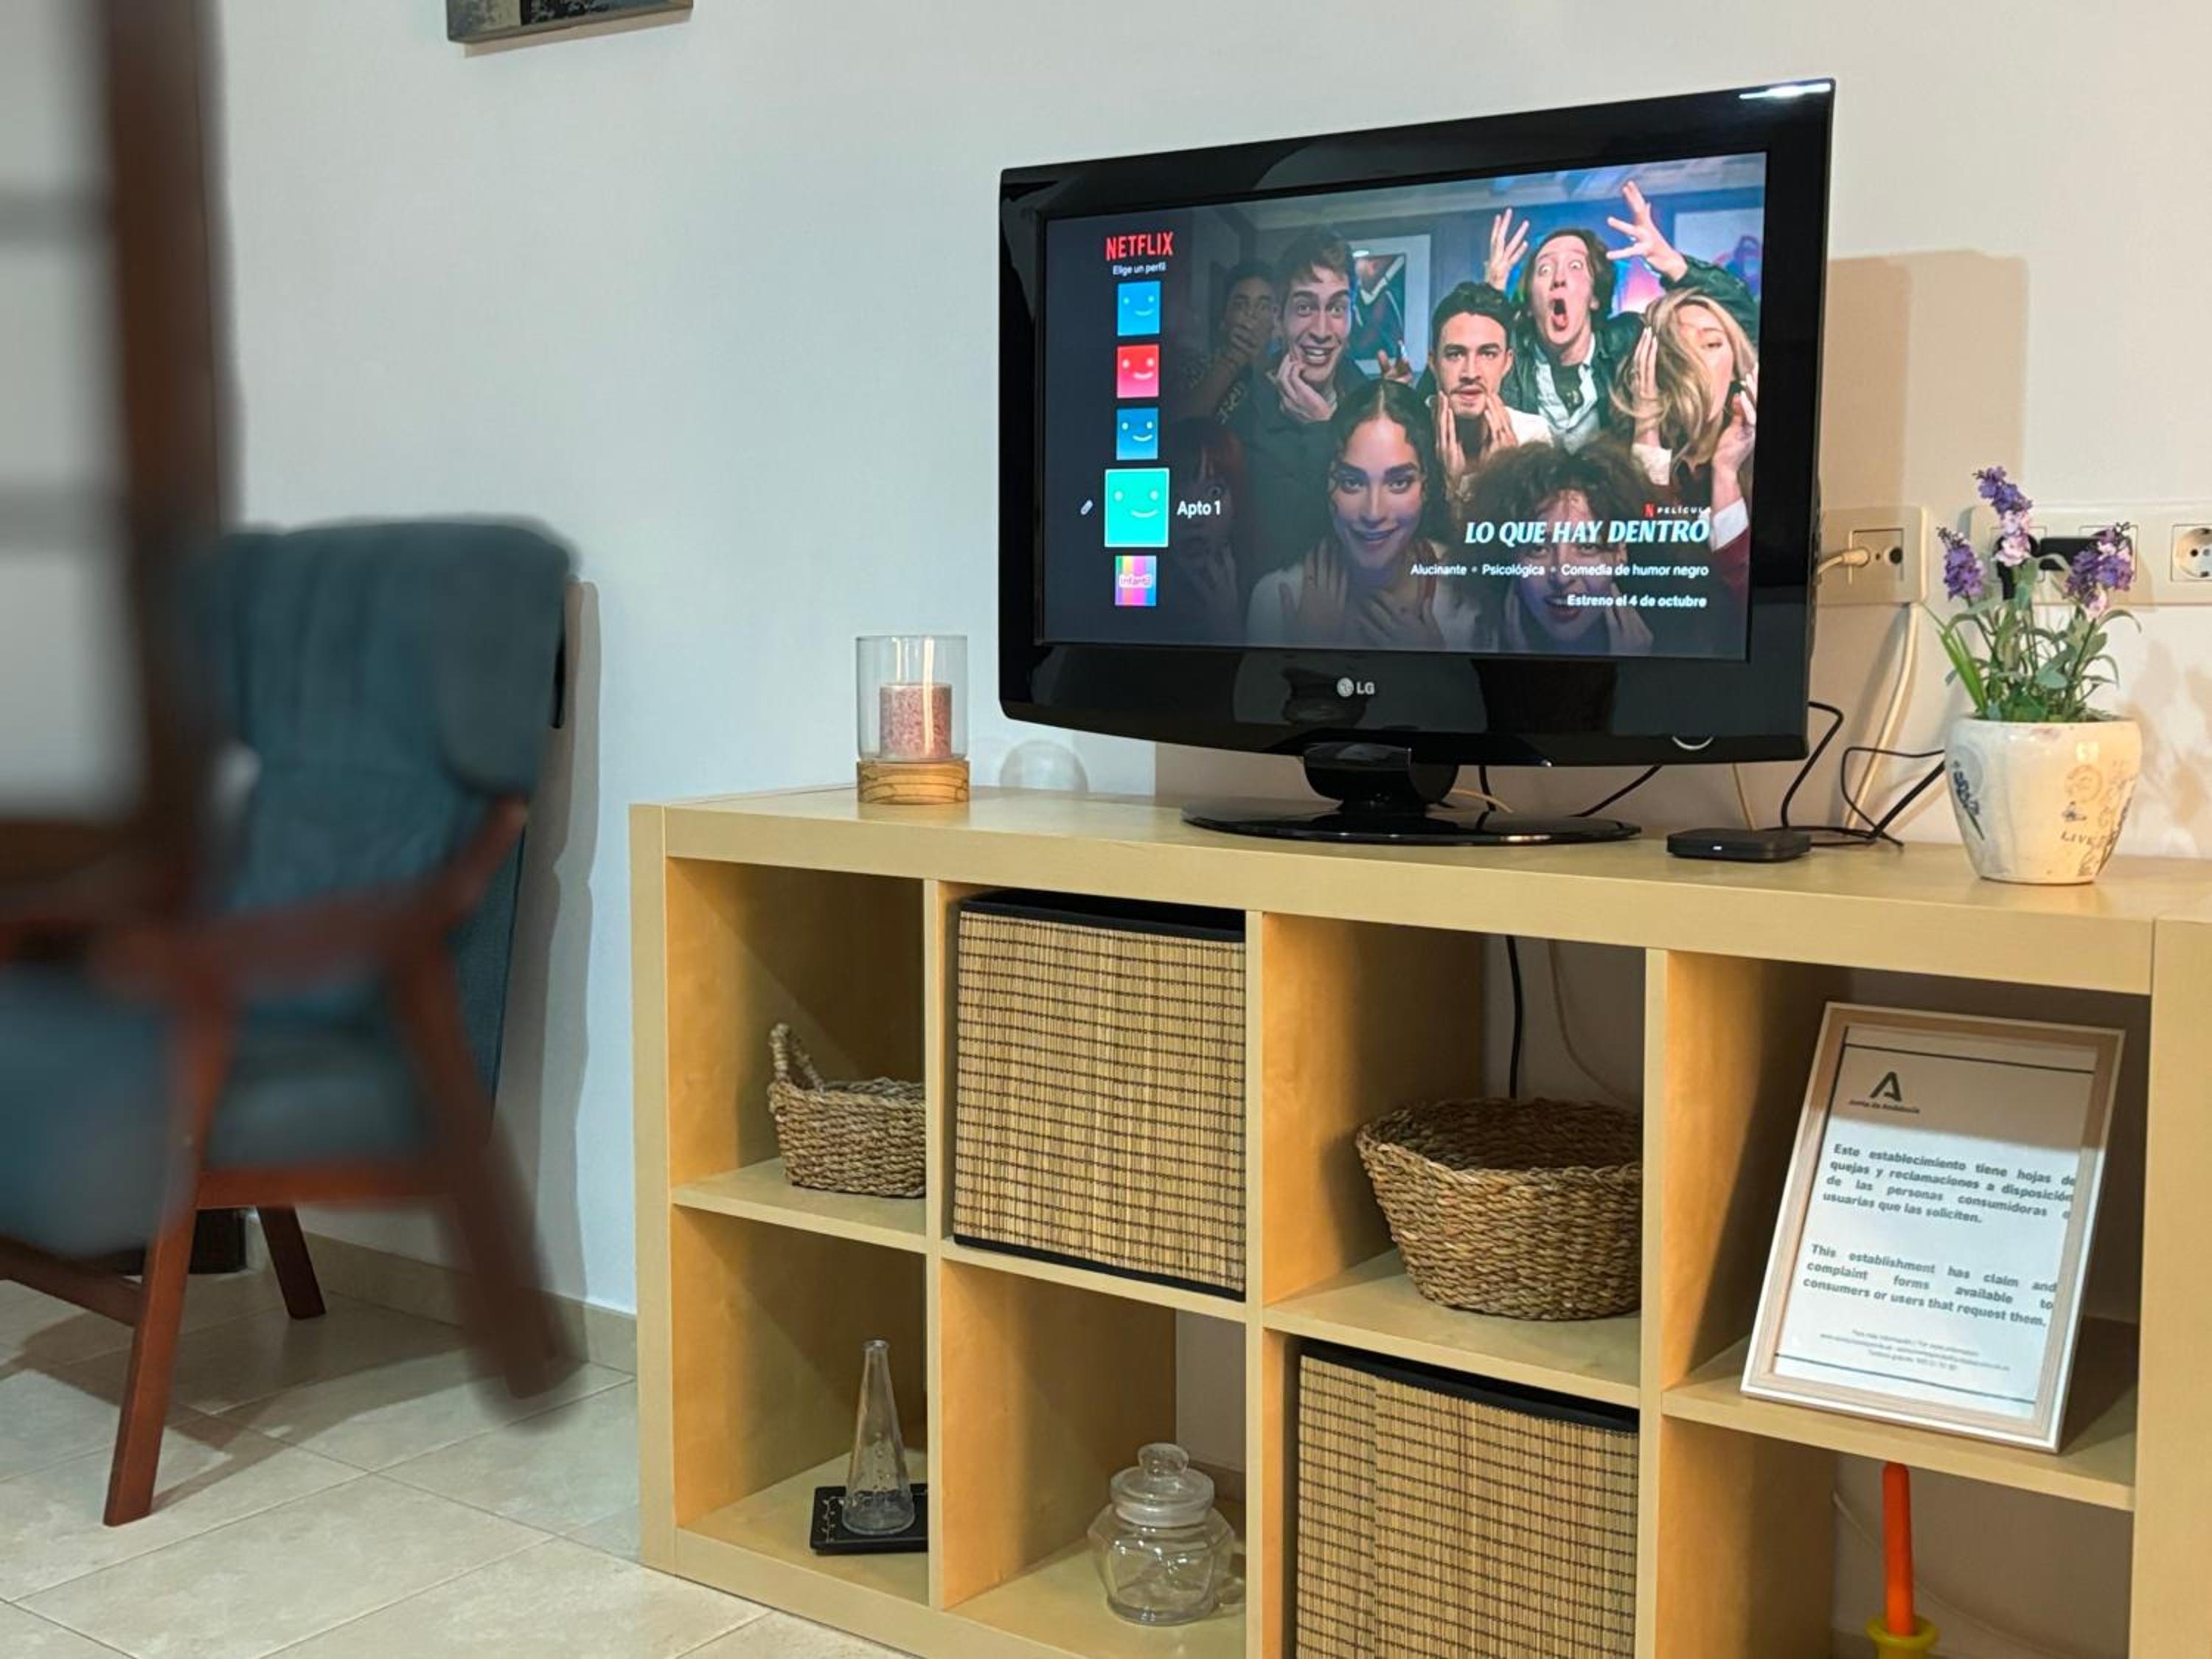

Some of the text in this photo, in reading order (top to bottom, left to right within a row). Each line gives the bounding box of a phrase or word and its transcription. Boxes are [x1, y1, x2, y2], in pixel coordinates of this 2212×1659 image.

[1106, 232, 1174, 260] NETFLIX
[1113, 262, 1166, 276] Elige un perfil
[1177, 500, 1221, 518] Apto 1
[1464, 519, 1710, 548] LO QUE HAY DENTRO
[1411, 563, 1709, 579] Alucinante Psicológica Comedia de humor negro
[1567, 594, 1707, 608] Estreno el 4 de octubre
[1356, 681, 1375, 695] LG
[1834, 1144, 1860, 1157] Este
[1869, 1150, 1966, 1170] establecimiento
[1975, 1163, 2007, 1177] tiene
[2017, 1169, 2051, 1183] hojas
[1826, 1175, 1842, 1186] de
[1856, 1180, 1873, 1191] las
[1887, 1186, 1943, 1201] personas
[1958, 1194, 2047, 1216] consumidoras
[1830, 1161, 2073, 1202] quejas y reclamaciones a disposición
[1823, 1193, 1982, 1223] usuarias que las soliciten.
[1812, 1244, 2057, 1292] This establishment has claim and
[1807, 1262, 2053, 1310] complaint forms available to
[1803, 1278, 2047, 1326] consumers or users that request them.
